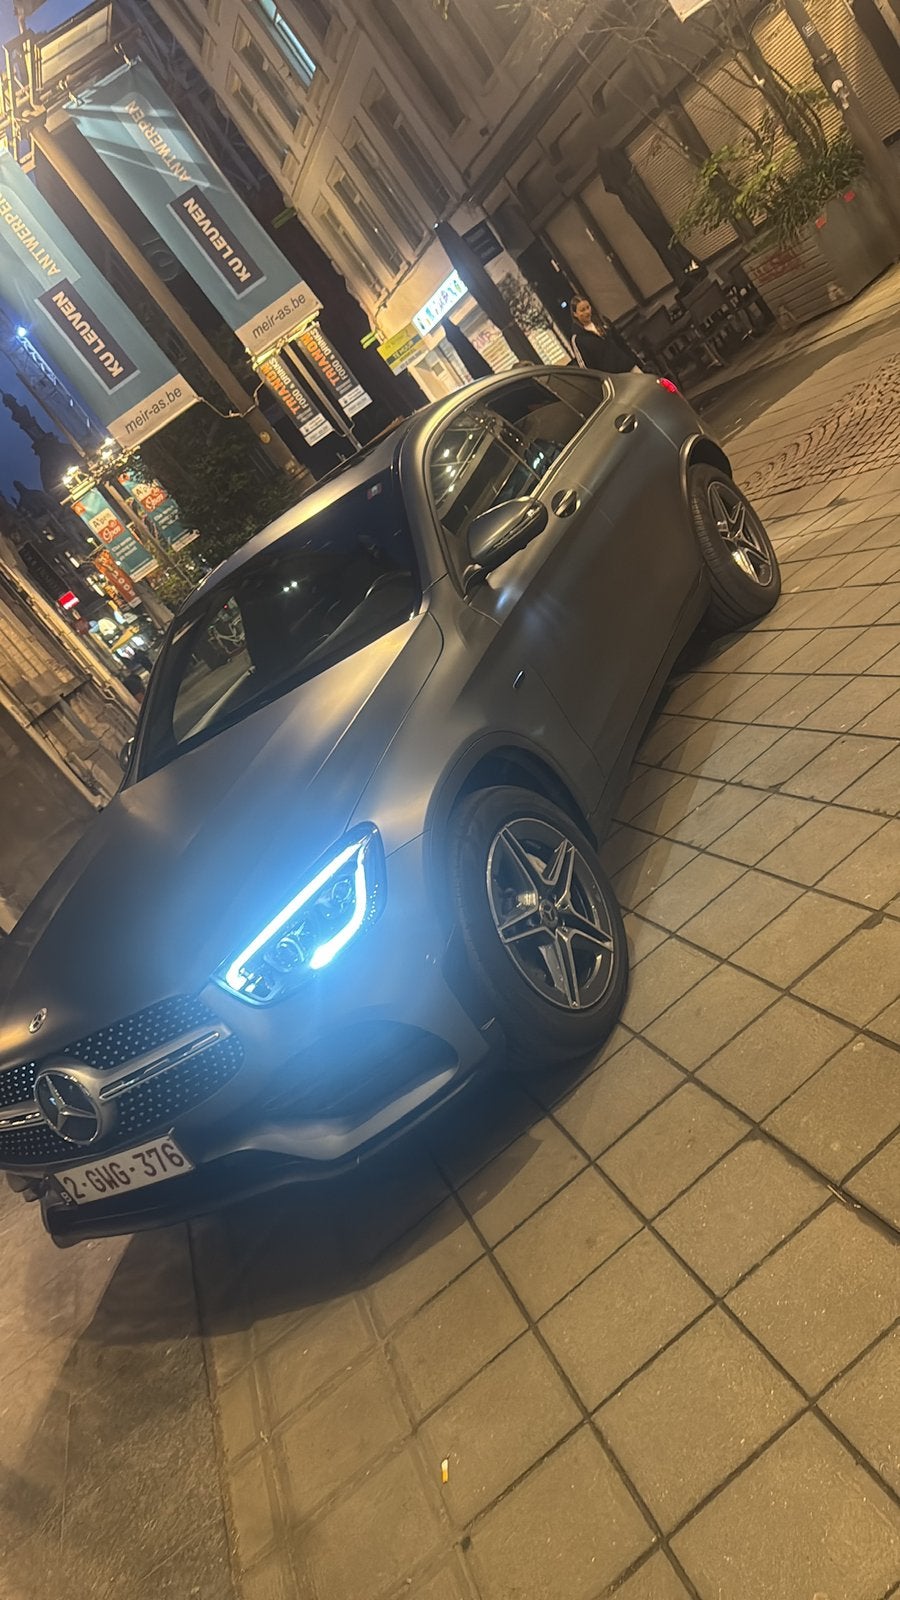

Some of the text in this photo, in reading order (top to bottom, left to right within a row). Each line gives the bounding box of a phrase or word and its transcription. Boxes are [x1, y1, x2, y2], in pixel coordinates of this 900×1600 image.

[125, 101, 191, 183] ANTWERPEN
[182, 197, 251, 284] KU LEUVEN
[52, 291, 124, 378] KU LEUVEN
[252, 293, 306, 339] meir-as.be
[300, 333, 341, 386] TRIANON
[311, 328, 332, 356] DRINKS
[259, 362, 299, 415] TRIANON
[268, 357, 292, 384] DRINKS
[331, 360, 348, 380] FOOD
[125, 386, 183, 435] meir-as.be
[292, 389, 309, 409] FOOD
